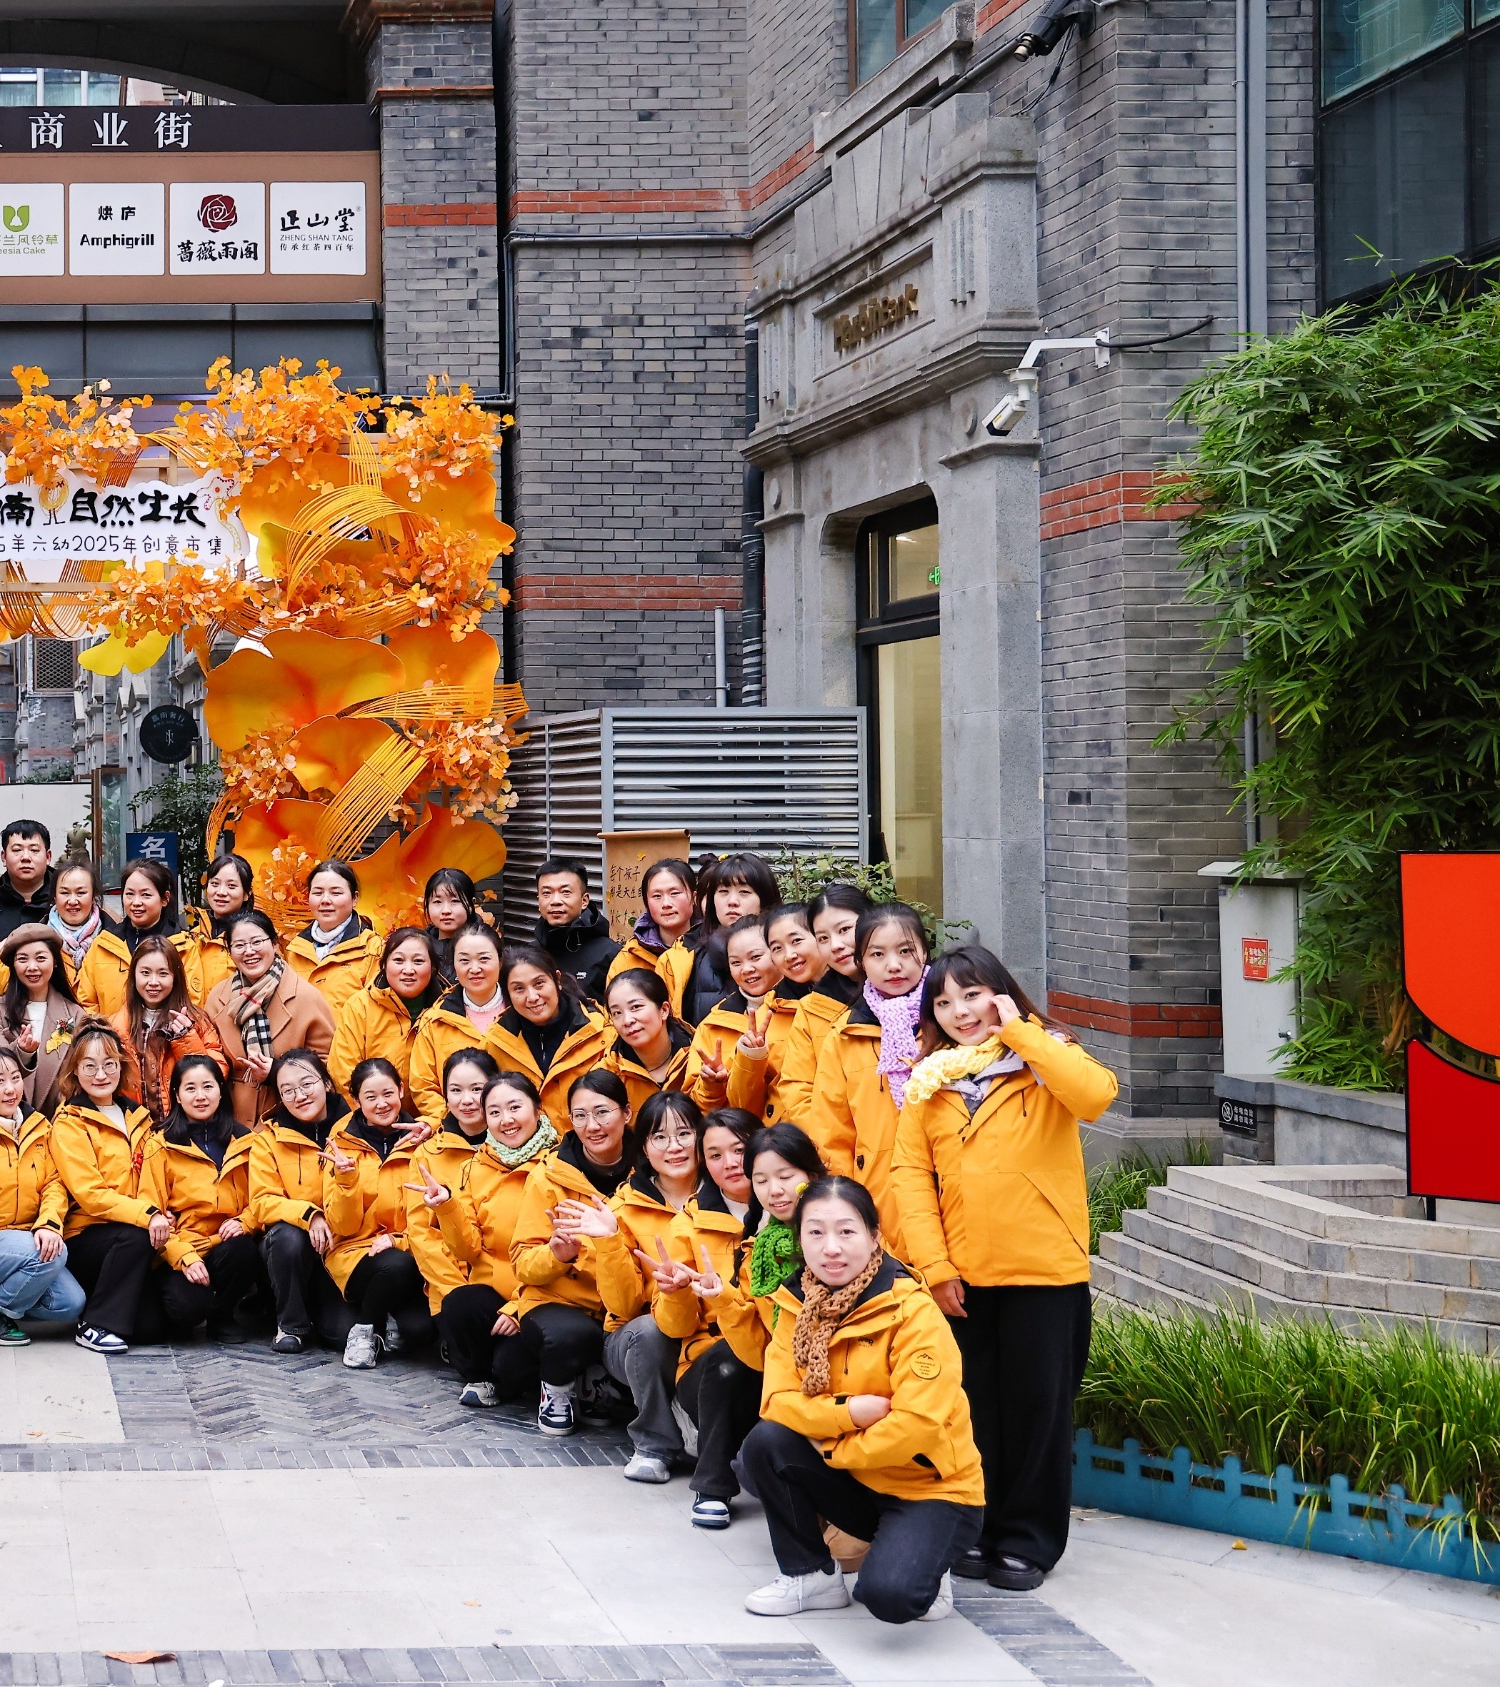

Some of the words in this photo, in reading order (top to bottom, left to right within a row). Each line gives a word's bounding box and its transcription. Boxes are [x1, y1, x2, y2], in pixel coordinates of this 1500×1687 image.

[280, 208, 355, 232] 正山堂
[80, 234, 155, 249] Amphigrill
[280, 234, 305, 242] ZHENG
[308, 234, 329, 242] SHAN
[332, 234, 354, 242] TANG
[23, 247, 46, 255] Cake
[177, 239, 258, 262] 蔷薇雨阁
[280, 243, 354, 251] 传承红茶四百年
[70, 487, 207, 528] 自然生长
